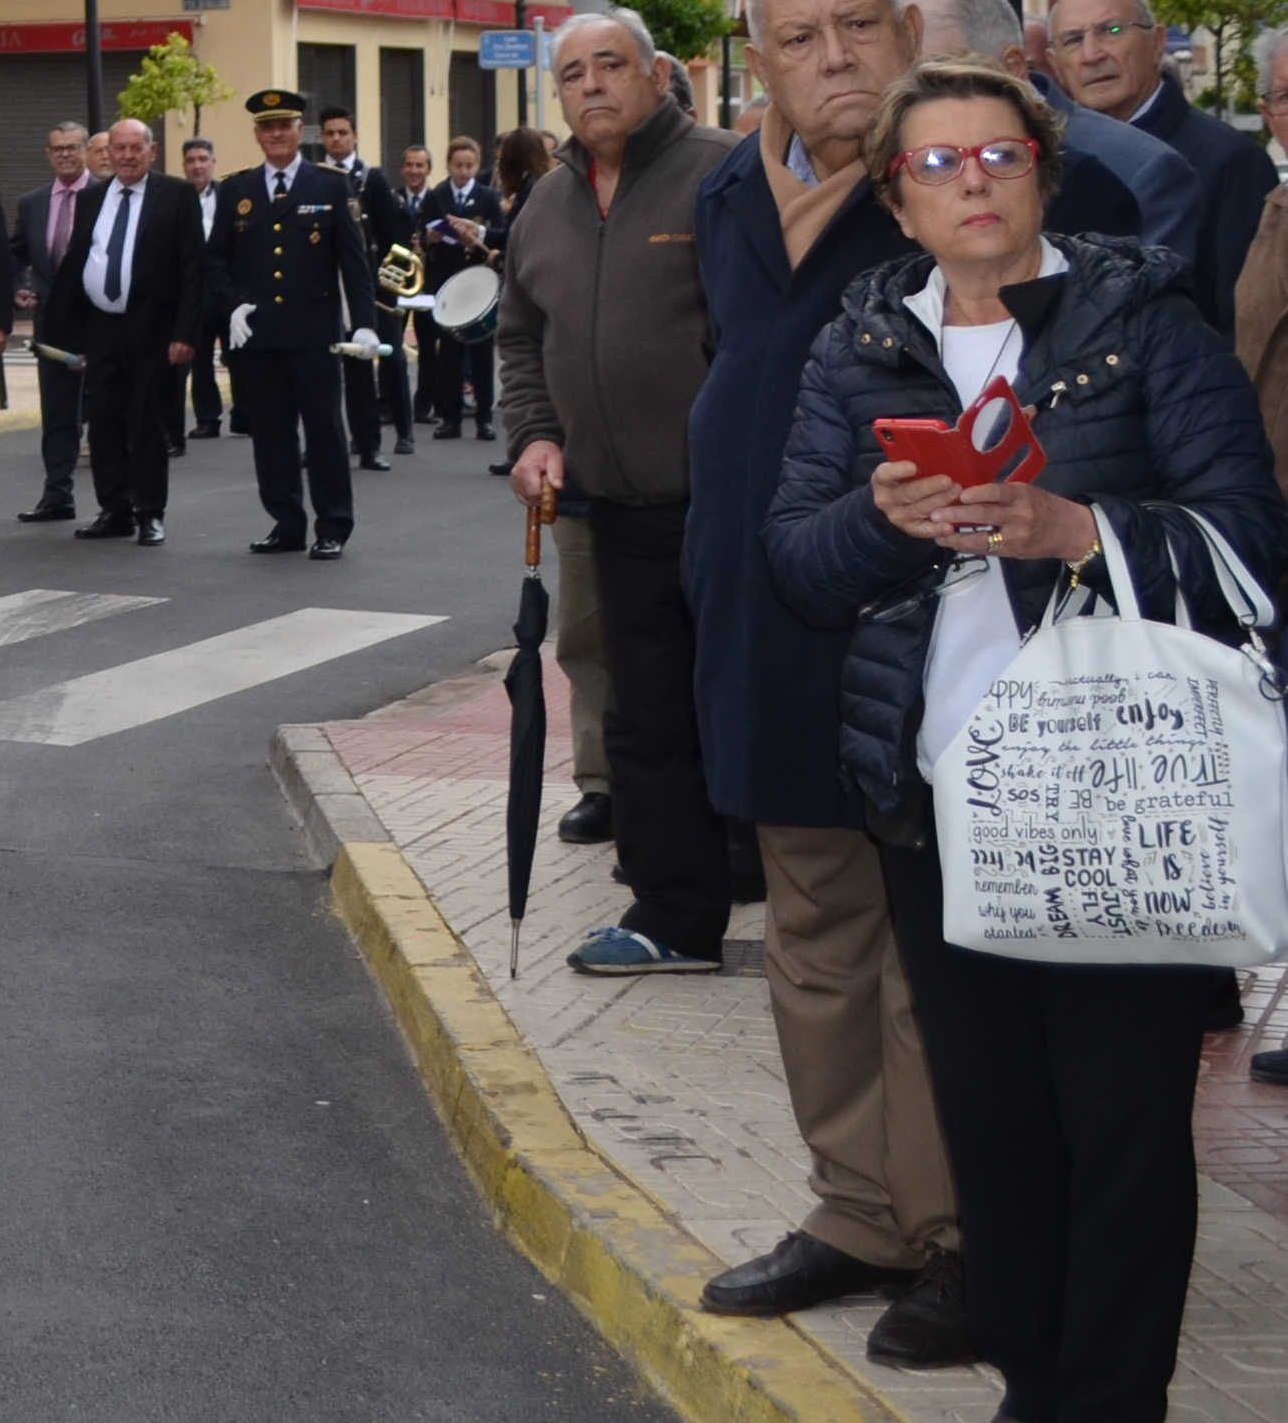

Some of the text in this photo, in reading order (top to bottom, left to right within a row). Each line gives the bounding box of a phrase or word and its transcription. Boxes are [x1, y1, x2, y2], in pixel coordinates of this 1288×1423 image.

[1116, 692, 1184, 730] enjoy
[1008, 711, 1101, 738] BE yourself
[1105, 790, 1235, 815] be grateful
[973, 815, 1098, 846] good vibes only
[1062, 845, 1117, 867] STAY
[1065, 868, 1117, 888] COOL
